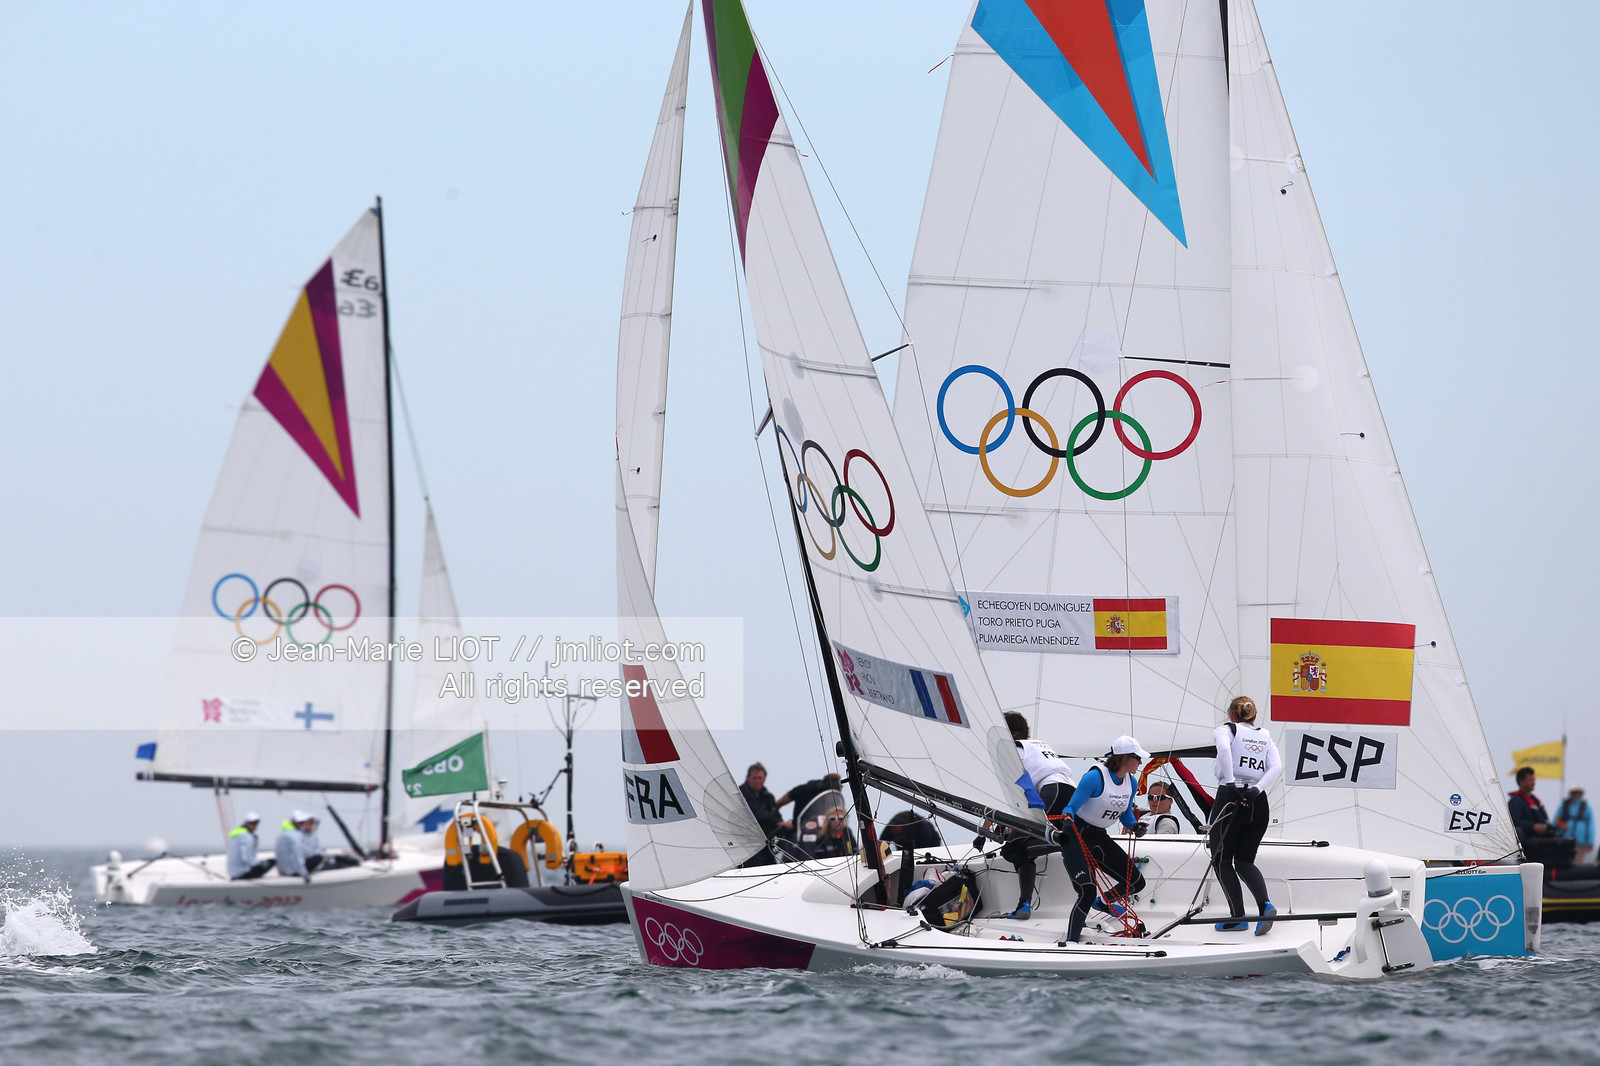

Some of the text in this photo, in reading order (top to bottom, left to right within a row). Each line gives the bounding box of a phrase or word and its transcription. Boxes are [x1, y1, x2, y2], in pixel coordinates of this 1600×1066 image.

[977, 600, 1091, 613] ECHEGOYEN DOMINGUEZ
[978, 617, 1061, 629] TORO PRIETO PUGA
[978, 634, 1080, 646] PUMARIEGA MENENDEZ
[1041, 750, 1056, 759] FR
[1295, 733, 1385, 783] ESP
[1239, 755, 1265, 772] FRA
[624, 773, 685, 820] FRA
[1449, 810, 1492, 832] ESP
